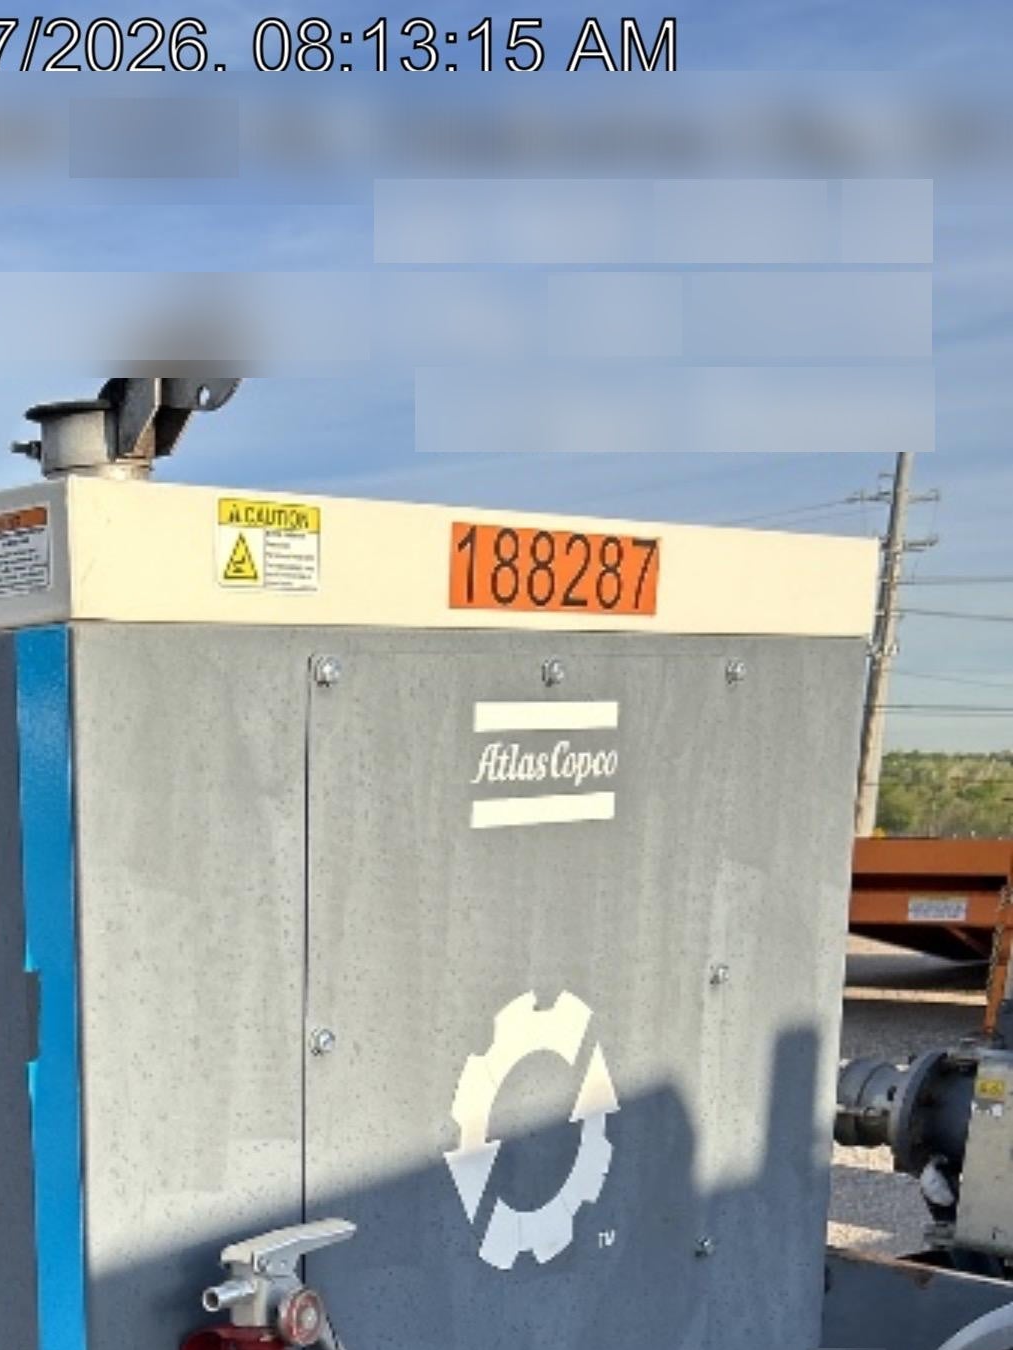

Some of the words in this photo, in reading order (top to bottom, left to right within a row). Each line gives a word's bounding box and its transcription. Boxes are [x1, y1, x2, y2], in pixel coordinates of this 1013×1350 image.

[244, 506, 309, 529] CAUTION
[457, 524, 657, 610] 188287
[471, 741, 548, 784] Atlas
[550, 740, 619, 787] Copco
